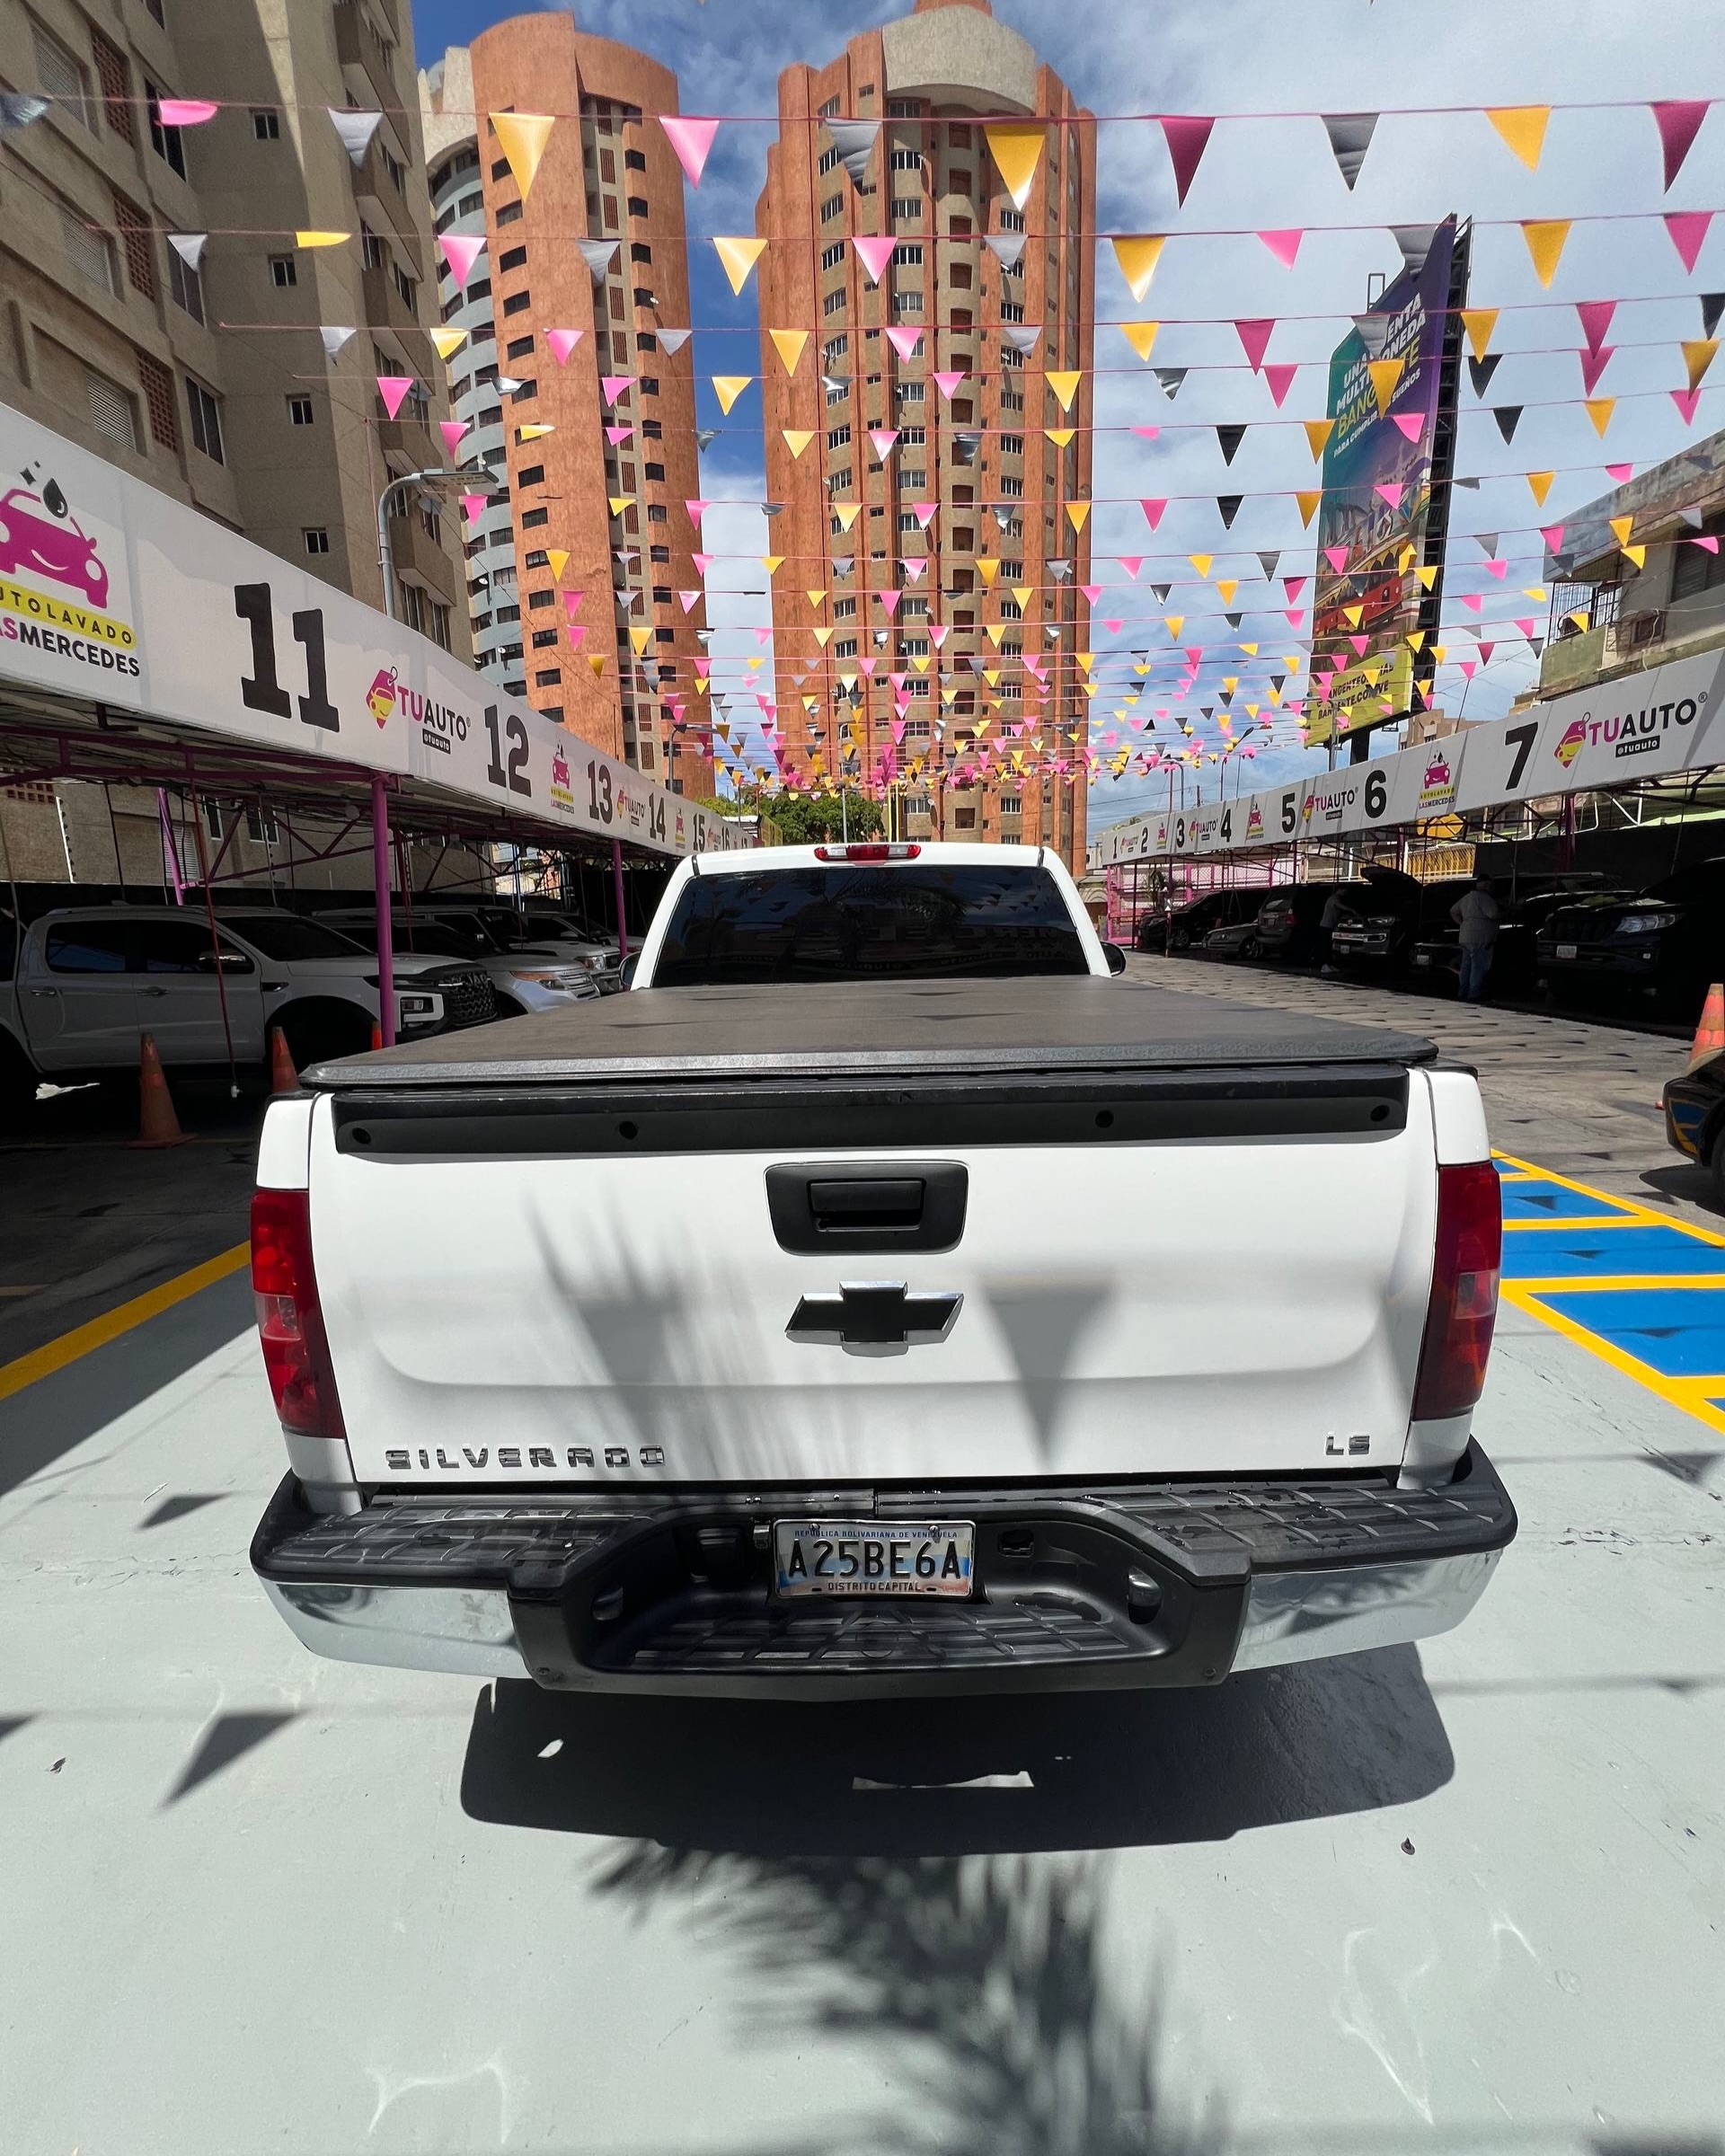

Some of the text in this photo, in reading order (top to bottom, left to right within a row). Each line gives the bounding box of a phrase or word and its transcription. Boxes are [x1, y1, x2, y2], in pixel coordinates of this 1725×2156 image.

[234, 582, 341, 732] 11
[484, 704, 532, 798] 12
[1505, 722, 1538, 791] 7
[588, 760, 614, 825] 13
[1365, 770, 1387, 819] 6
[649, 792, 666, 843] 14
[693, 813, 704, 853] 15
[1176, 817, 1185, 848] 3
[1221, 808, 1232, 843] 4
[1281, 792, 1296, 834] 5
[1113, 835, 1118, 860] 1
[1141, 826, 1148, 853] 2
[385, 1445, 666, 1469] SILVERADO
[842, 1530, 896, 1539] BOLIVARIANA
[788, 1539, 961, 1579] A25BE6A
[827, 1581, 921, 1591] DISTRITO CAPITAL
